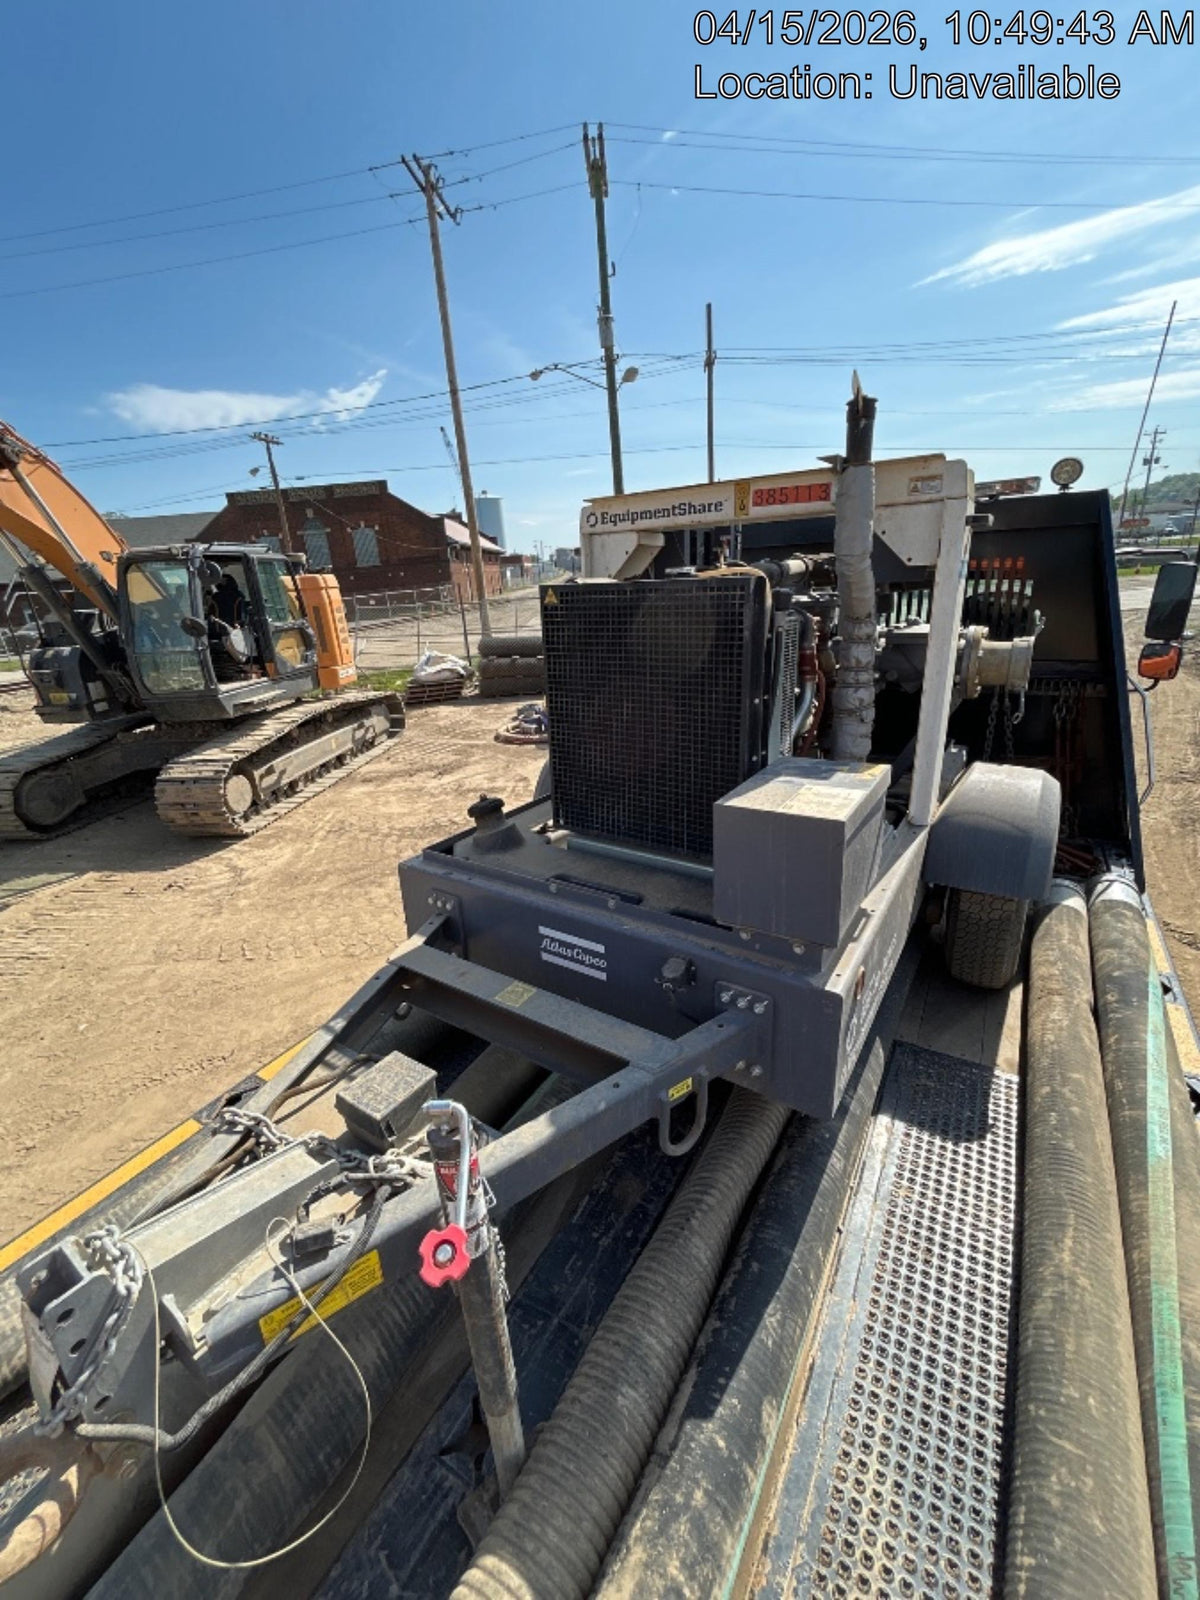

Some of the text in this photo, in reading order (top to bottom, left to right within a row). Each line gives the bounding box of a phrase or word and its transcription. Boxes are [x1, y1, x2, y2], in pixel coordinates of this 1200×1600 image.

[754, 483, 829, 507] 385113
[600, 500, 723, 527] EquipmentShare
[540, 938, 607, 968] Atlas Copco
